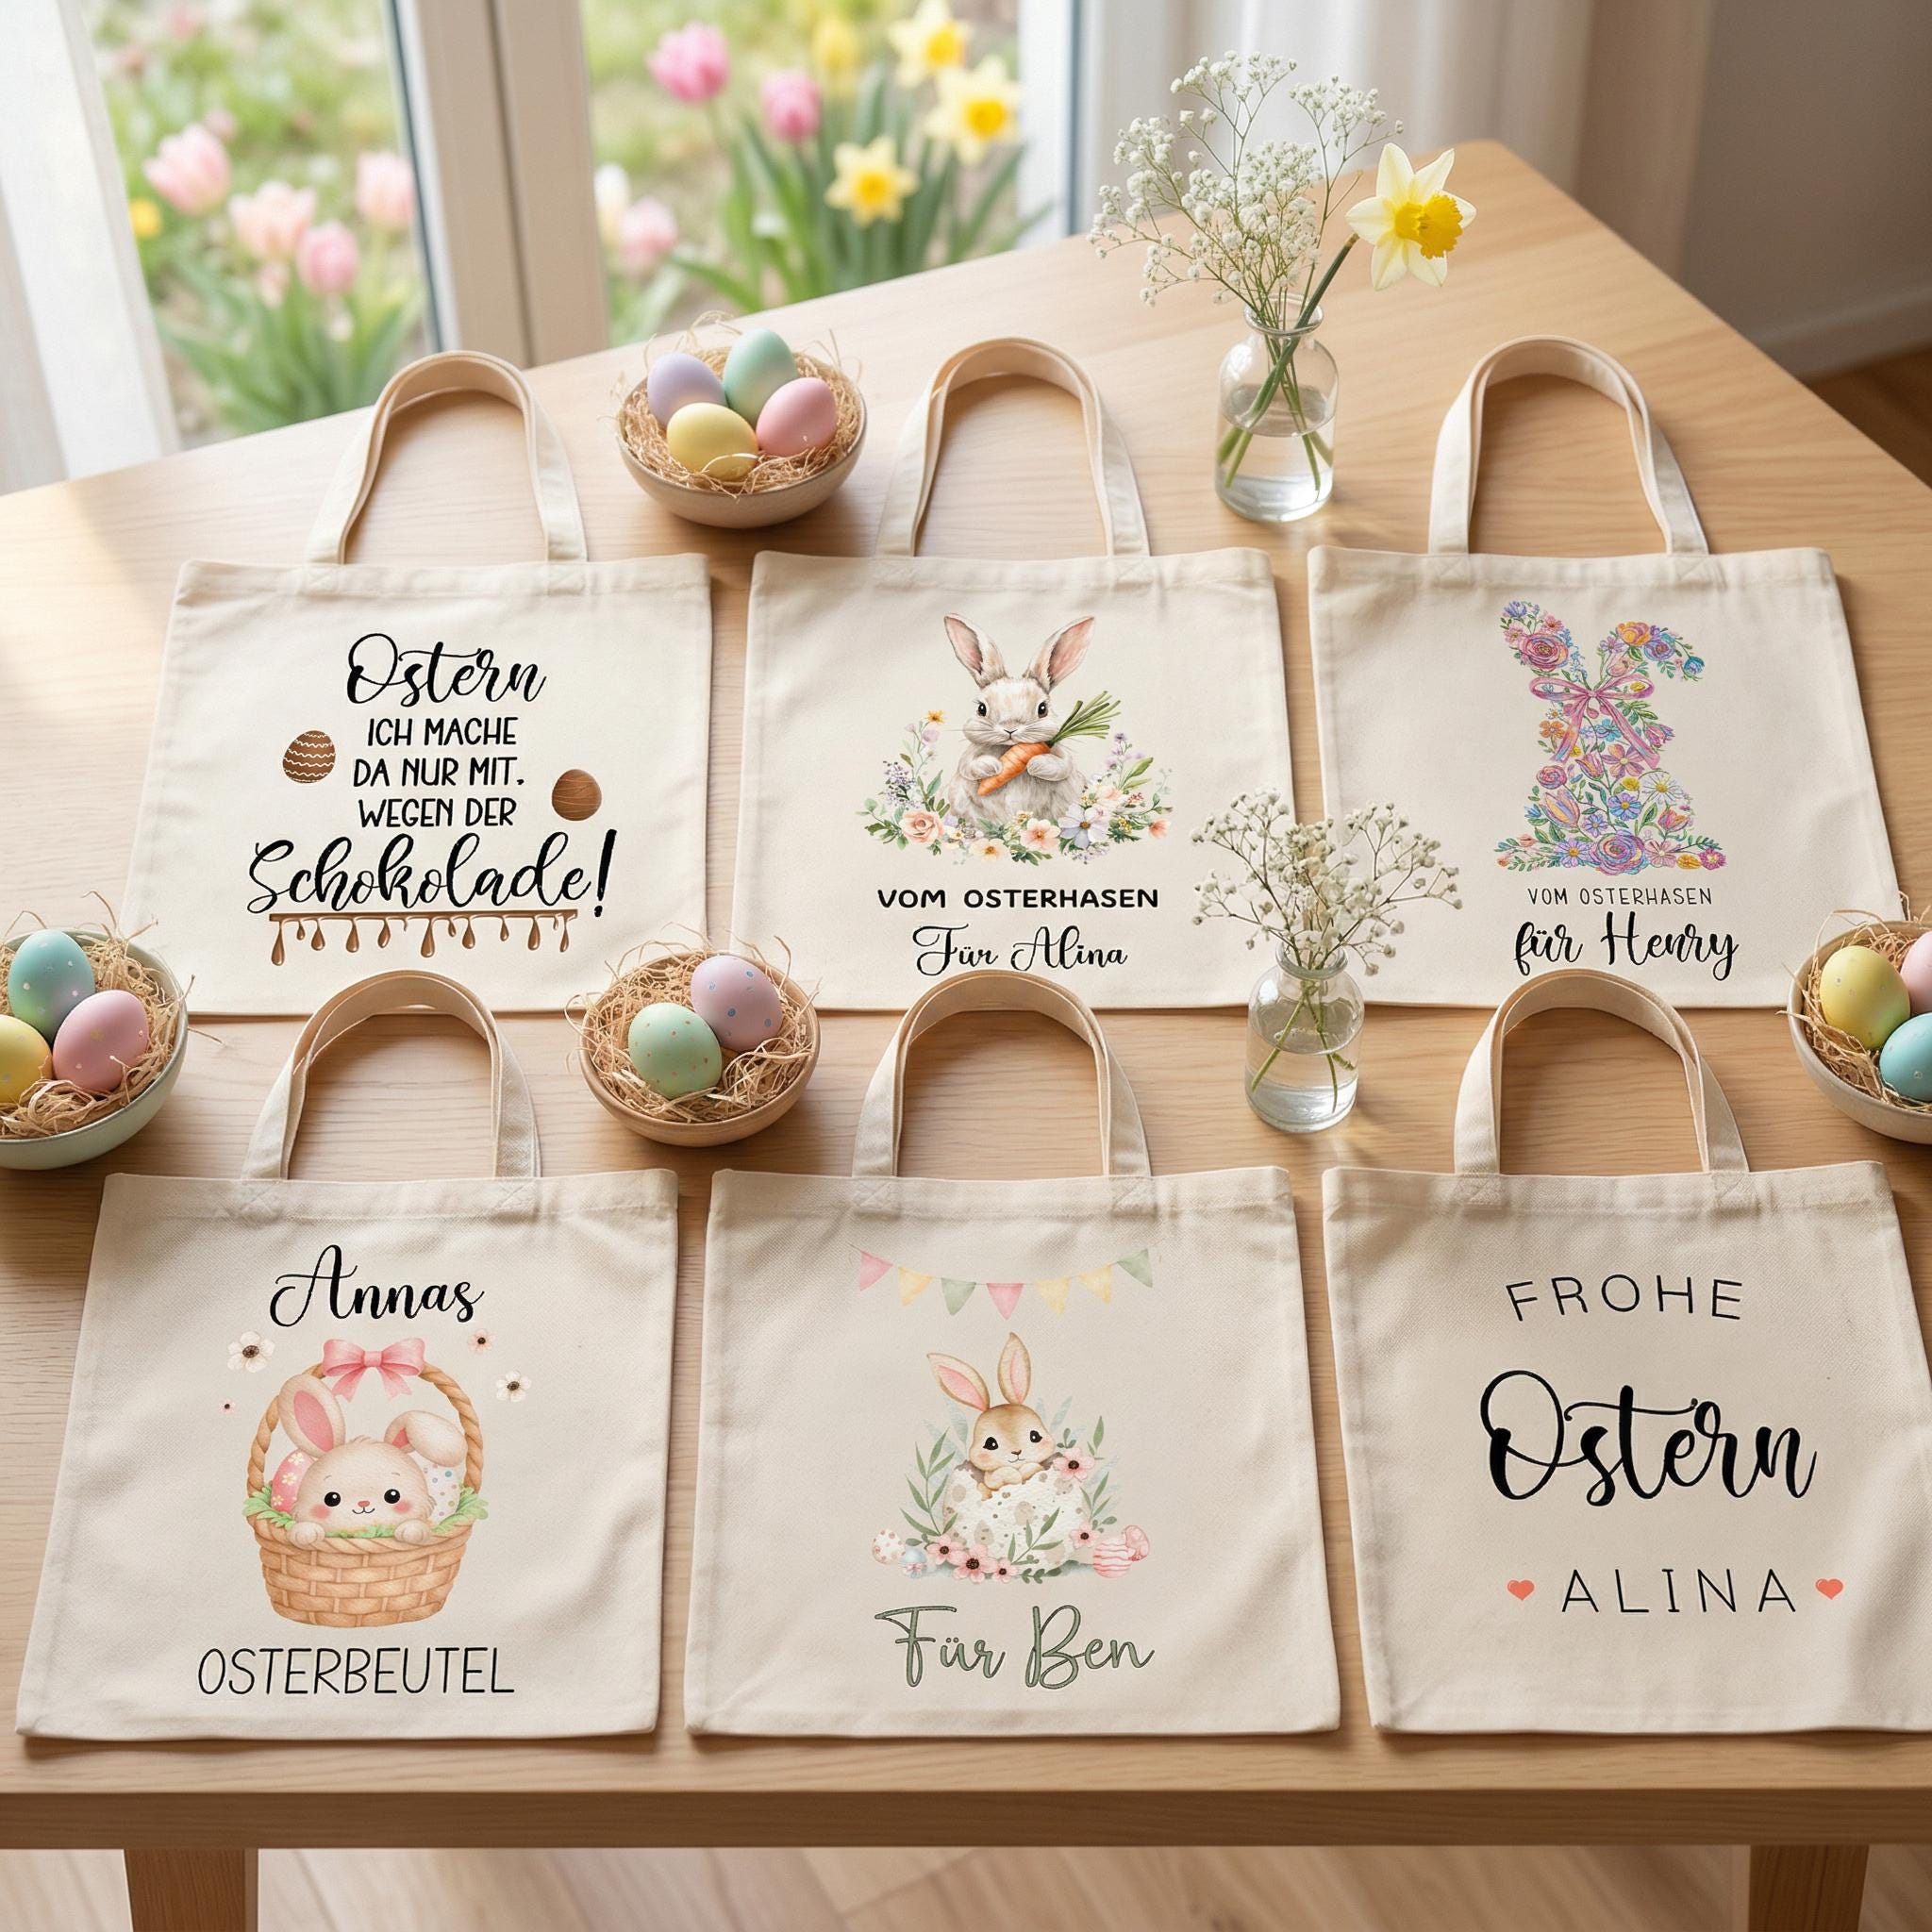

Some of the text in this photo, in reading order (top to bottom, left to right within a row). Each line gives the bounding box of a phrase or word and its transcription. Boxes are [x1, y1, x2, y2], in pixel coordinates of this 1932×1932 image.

[347, 632, 548, 708] Ostern
[367, 716, 519, 747] ICH MACHE
[353, 757, 525, 788] DA NUR MIT.
[358, 797, 517, 828] WEGEN DER
[246, 829, 617, 918] Schokolade!
[1527, 887, 1712, 906] VOM OSTERHASEN
[877, 889, 1158, 908] VOM OSTERHASEN
[912, 924, 1128, 975] Für Alina
[1513, 910, 1740, 981] für Henry
[269, 1244, 485, 1327] Annas
[1505, 1274, 1742, 1322] FROHE
[1480, 1370, 1818, 1507] Ostern
[1561, 1568, 1796, 1613] ALINA
[197, 1646, 515, 1695] OSTERBEUTEL
[874, 1604, 1156, 1690] Für Ben
